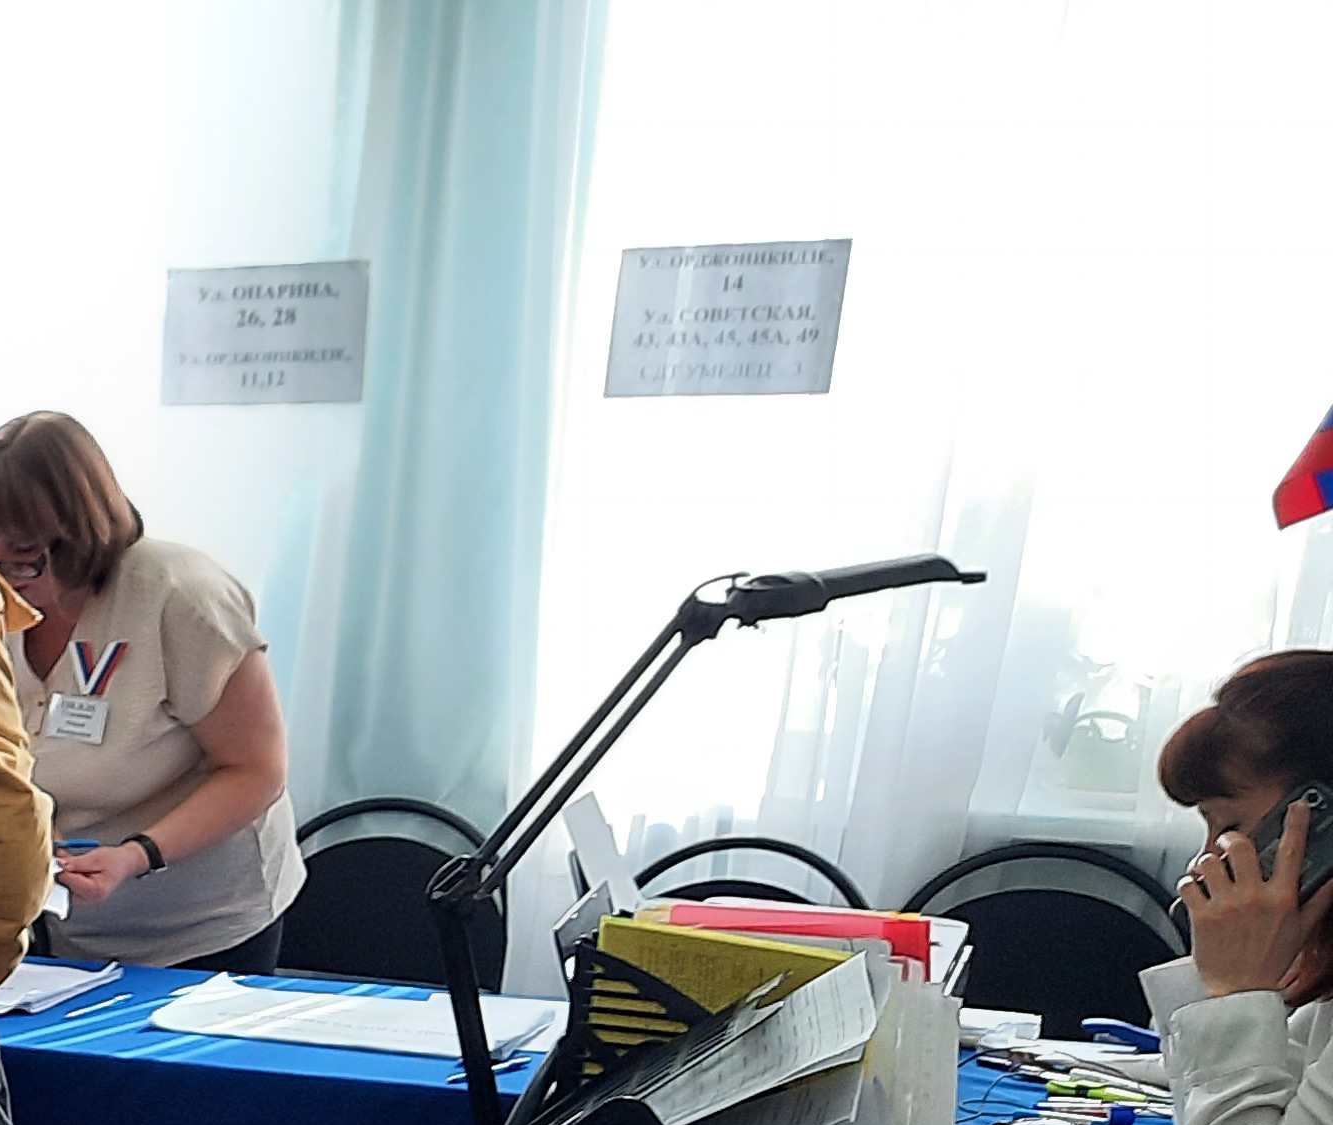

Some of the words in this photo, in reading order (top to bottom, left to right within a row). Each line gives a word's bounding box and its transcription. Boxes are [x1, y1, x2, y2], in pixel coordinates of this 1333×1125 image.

[721, 274, 744, 292] 14
[272, 306, 298, 327] 28
[795, 327, 821, 344] 49
